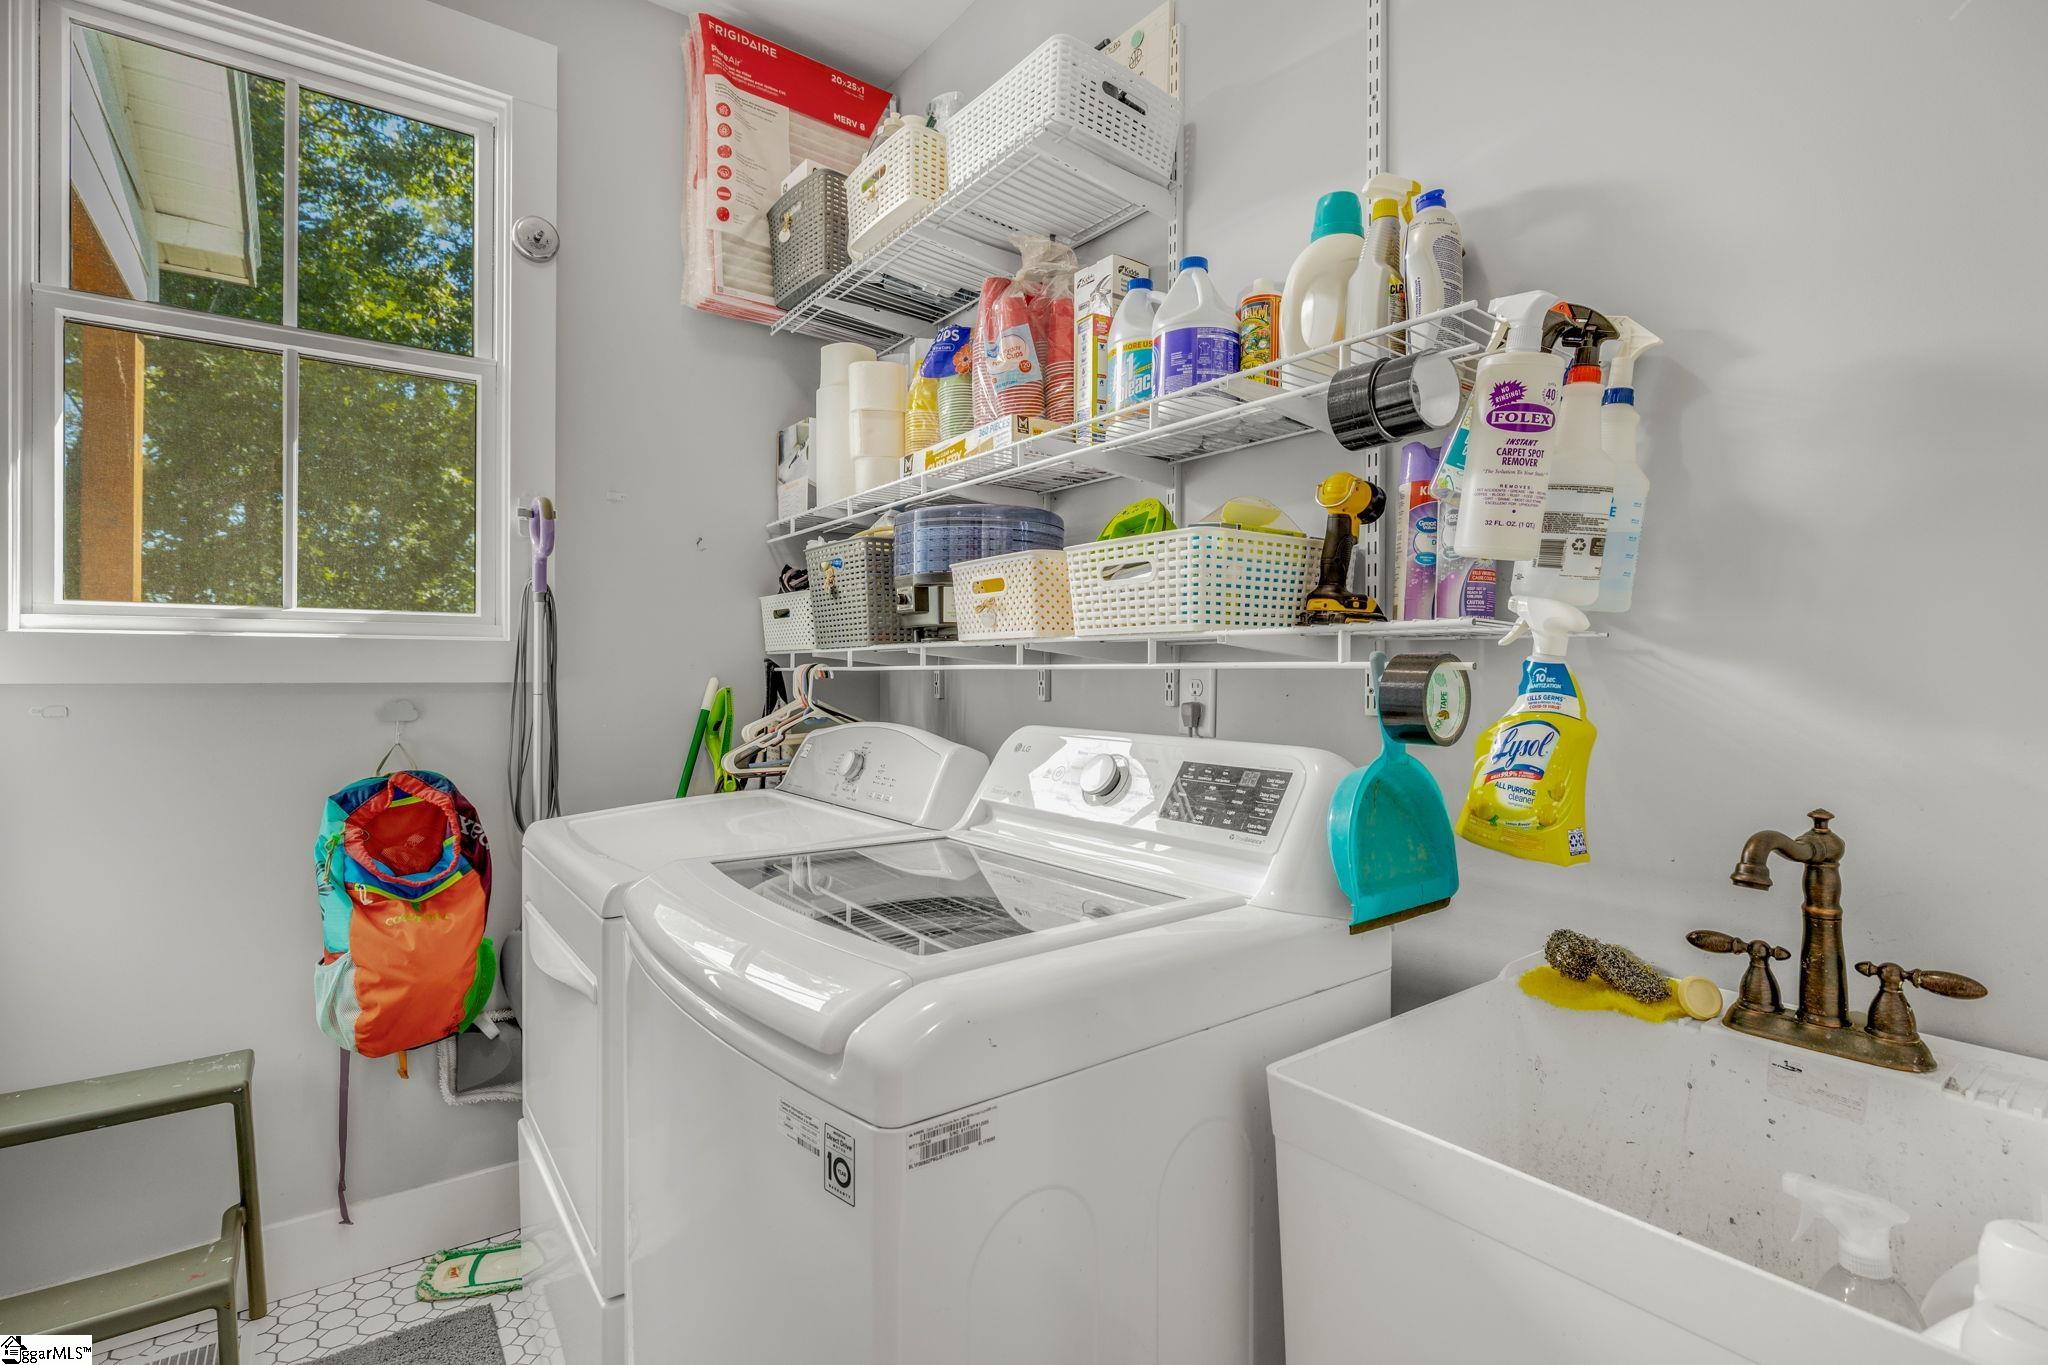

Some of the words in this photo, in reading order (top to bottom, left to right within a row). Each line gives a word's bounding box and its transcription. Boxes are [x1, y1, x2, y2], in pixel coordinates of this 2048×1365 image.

[708, 20, 778, 58] FRIGIDAIRE
[832, 74, 864, 94] 20x25x1
[834, 113, 857, 128] MERV
[860, 123, 865, 131] 8
[936, 329, 960, 342] UPS
[1144, 340, 1152, 348] US
[1495, 390, 1521, 402] RINSING!
[1546, 389, 1555, 400] 40
[1494, 412, 1550, 424] FOLEX
[1506, 438, 1539, 446] INSTANT
[1496, 448, 1526, 456] CARPET
[1528, 449, 1544, 458] SPOT
[1502, 457, 1538, 467] REMOVER
[1536, 674, 1546, 682] 10
[1440, 691, 1448, 710] TAPE
[1492, 728, 1555, 768] Lysol
[1495, 781, 1505, 790] ALL
[1507, 785, 1536, 796] PURPOSE
[1508, 793, 1535, 804] cleaner
[827, 1132, 839, 1145] Direct
[840, 1140, 852, 1152] Drive
[827, 1151, 851, 1188] 10
[838, 1168, 847, 1178] YEAR
